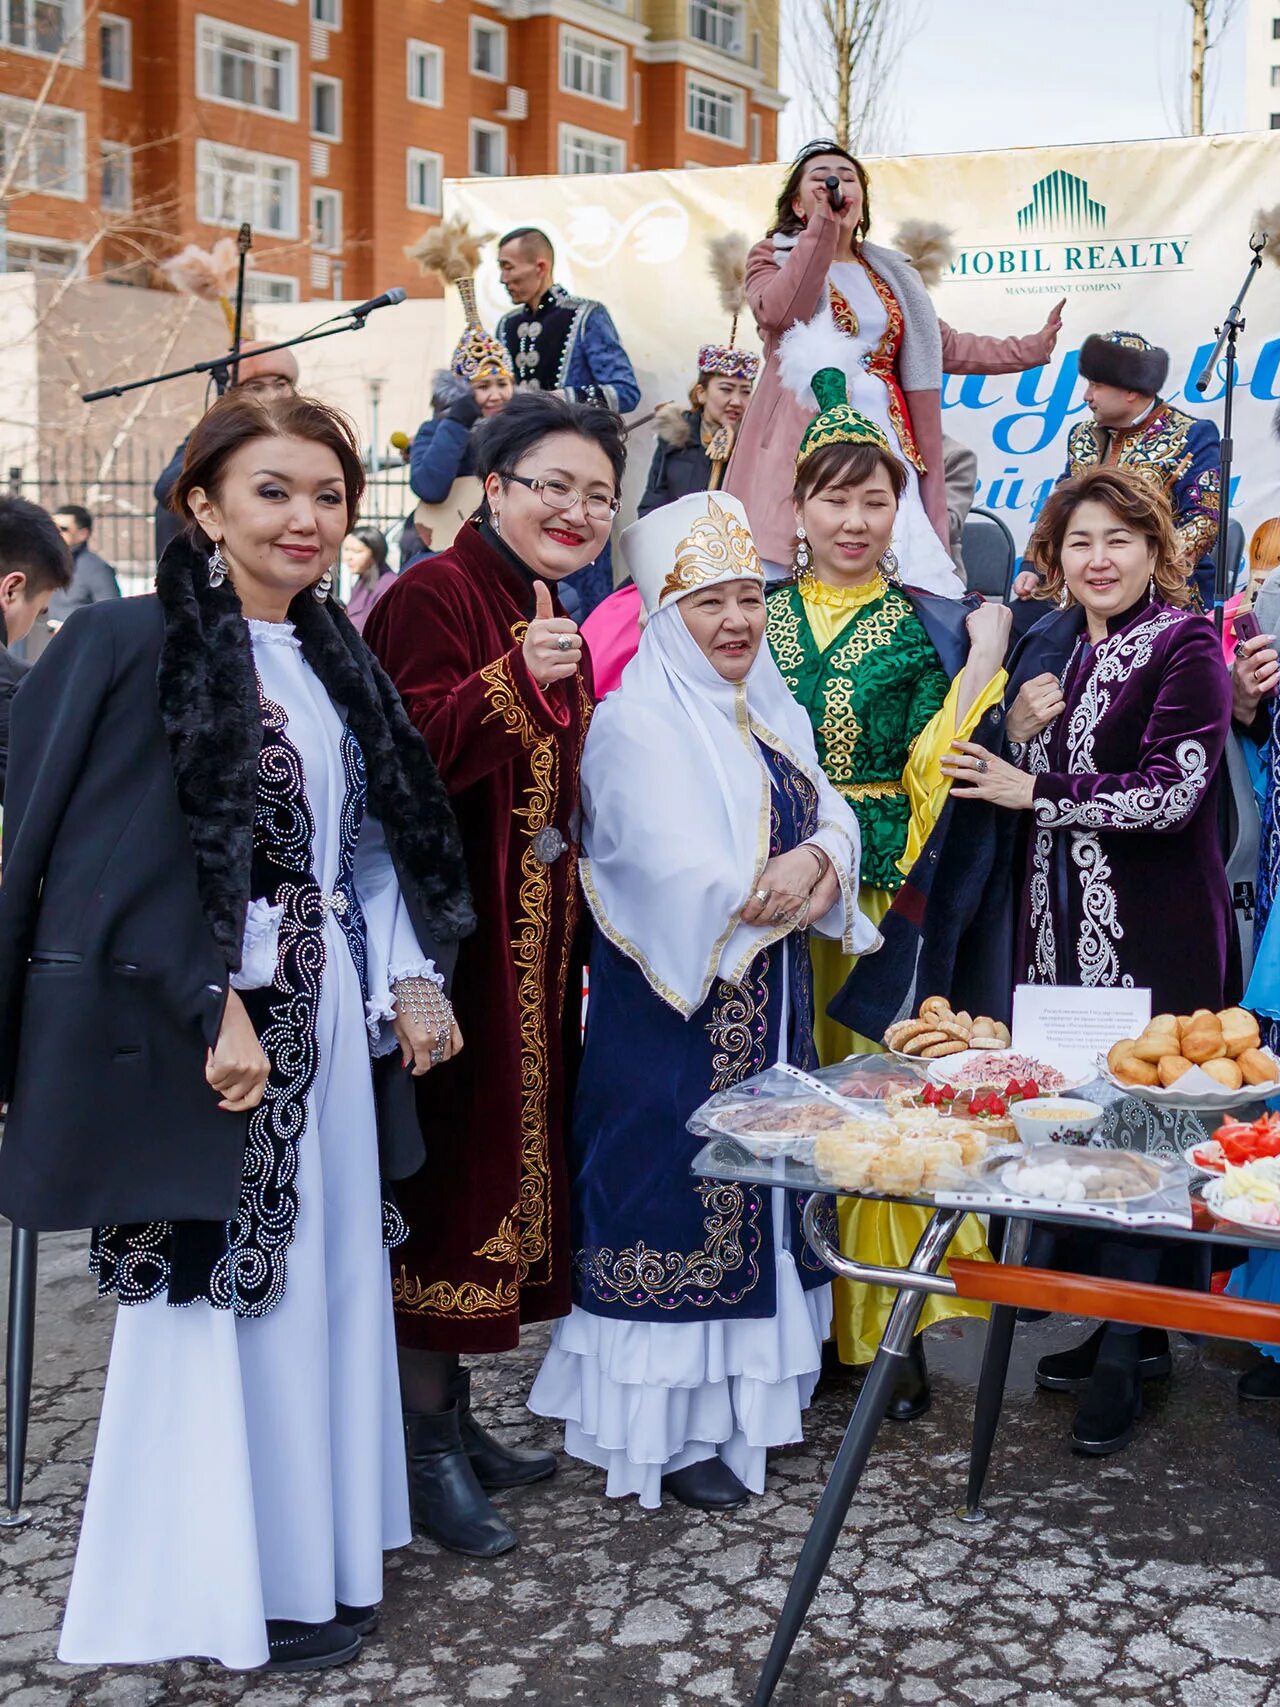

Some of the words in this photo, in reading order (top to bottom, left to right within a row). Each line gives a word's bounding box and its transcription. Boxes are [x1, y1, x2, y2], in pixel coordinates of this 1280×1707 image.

[943, 249, 1051, 276] MOBIL
[1064, 240, 1189, 271] REALTY
[1005, 285, 1072, 295] MANAGEMENT
[1075, 282, 1123, 293] COMPANY
